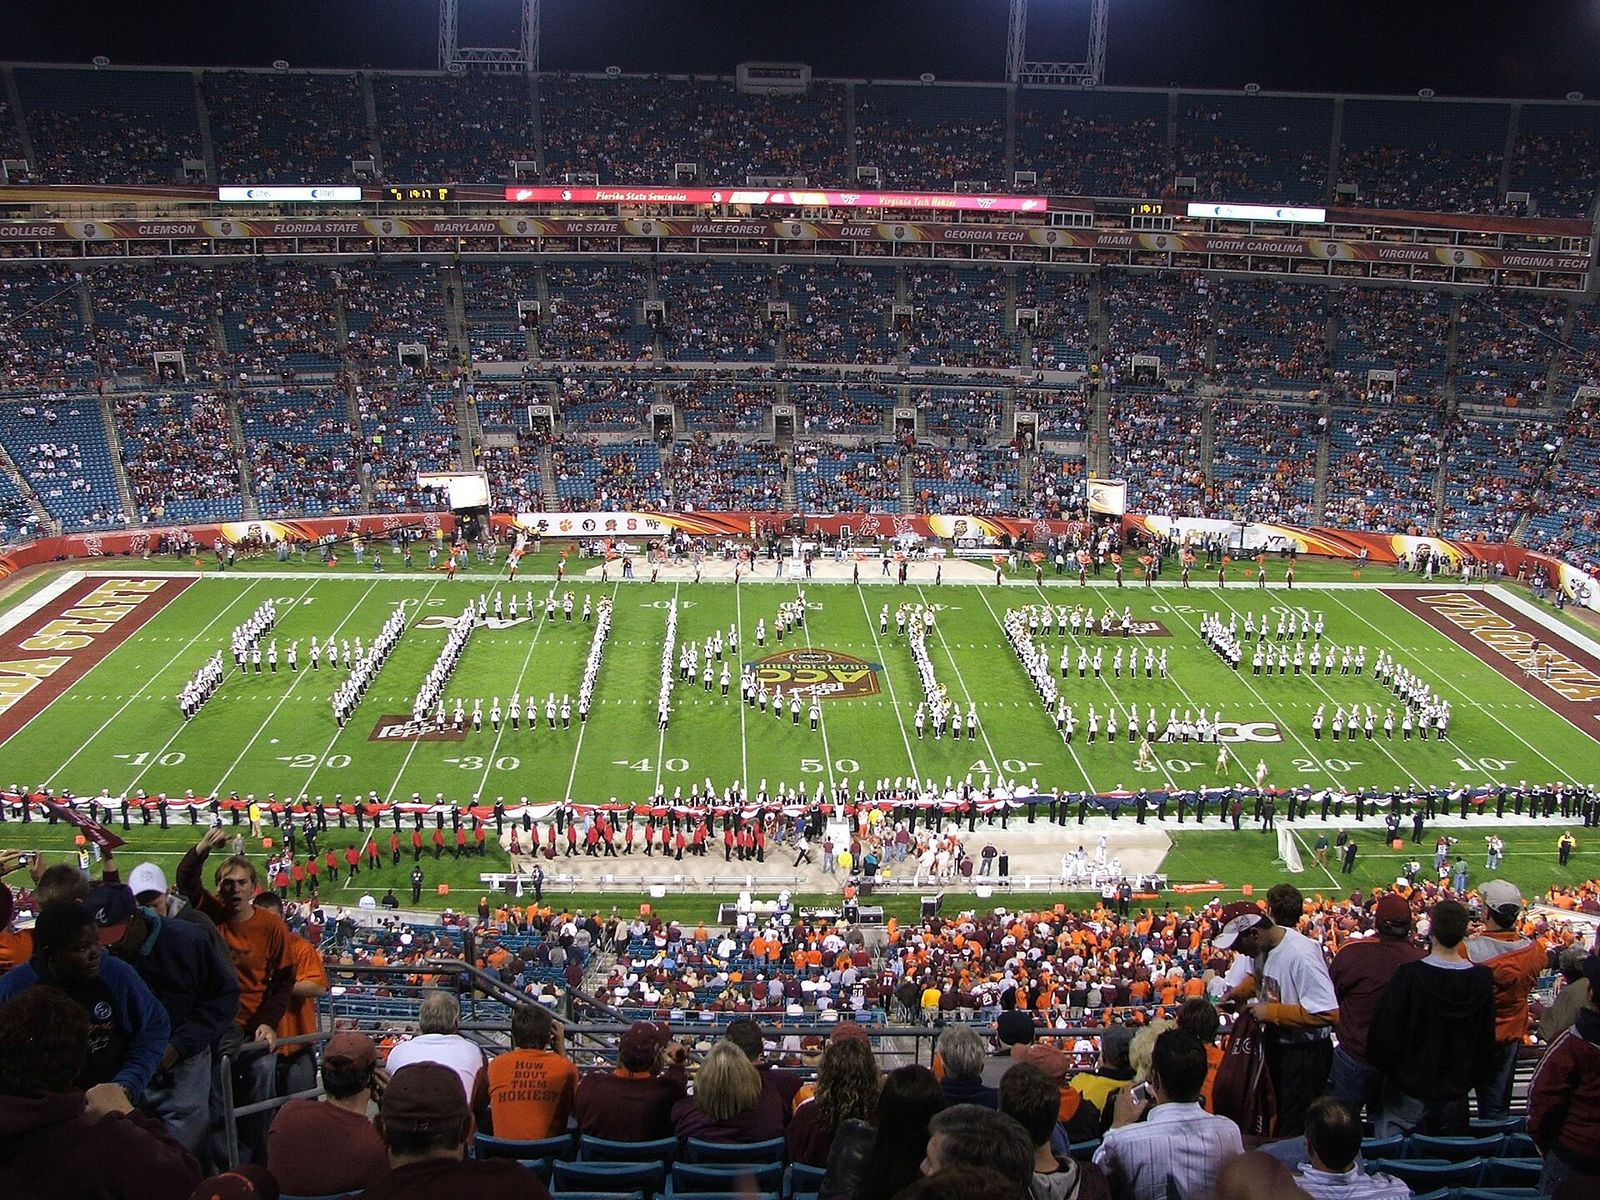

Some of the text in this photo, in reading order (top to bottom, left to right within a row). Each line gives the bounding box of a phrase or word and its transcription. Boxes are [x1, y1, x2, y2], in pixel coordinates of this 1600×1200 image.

[625, 192, 646, 201] State
[0, 226, 56, 237] COLLEGE
[138, 225, 196, 234] CLEMSON
[274, 223, 359, 233] FLORIDA STATE
[433, 223, 496, 233] MARYLAND
[566, 223, 618, 232] NC STATE
[691, 224, 767, 235] WAKE FOREST
[841, 227, 872, 237] DUKE
[944, 229, 1025, 241] GEORGIA TECH
[1097, 235, 1133, 245] MIAMI
[1206, 240, 1303, 253] NORTH CAROLINA
[1378, 248, 1430, 260] VIRGINIA
[1502, 255, 1590, 270] VIRGINIA TECH
[124, 751, 187, 767] 10
[289, 753, 353, 769] 20
[457, 755, 521, 771] 30
[1452, 757, 1507, 771] 10
[628, 757, 691, 773] 40
[800, 758, 861, 774] 50
[968, 758, 1029, 773] 40
[1290, 758, 1352, 773] 20
[515, 1061, 545, 1070] HOW
[514, 1071, 549, 1079] BOUT
[510, 1080, 547, 1089] THEM
